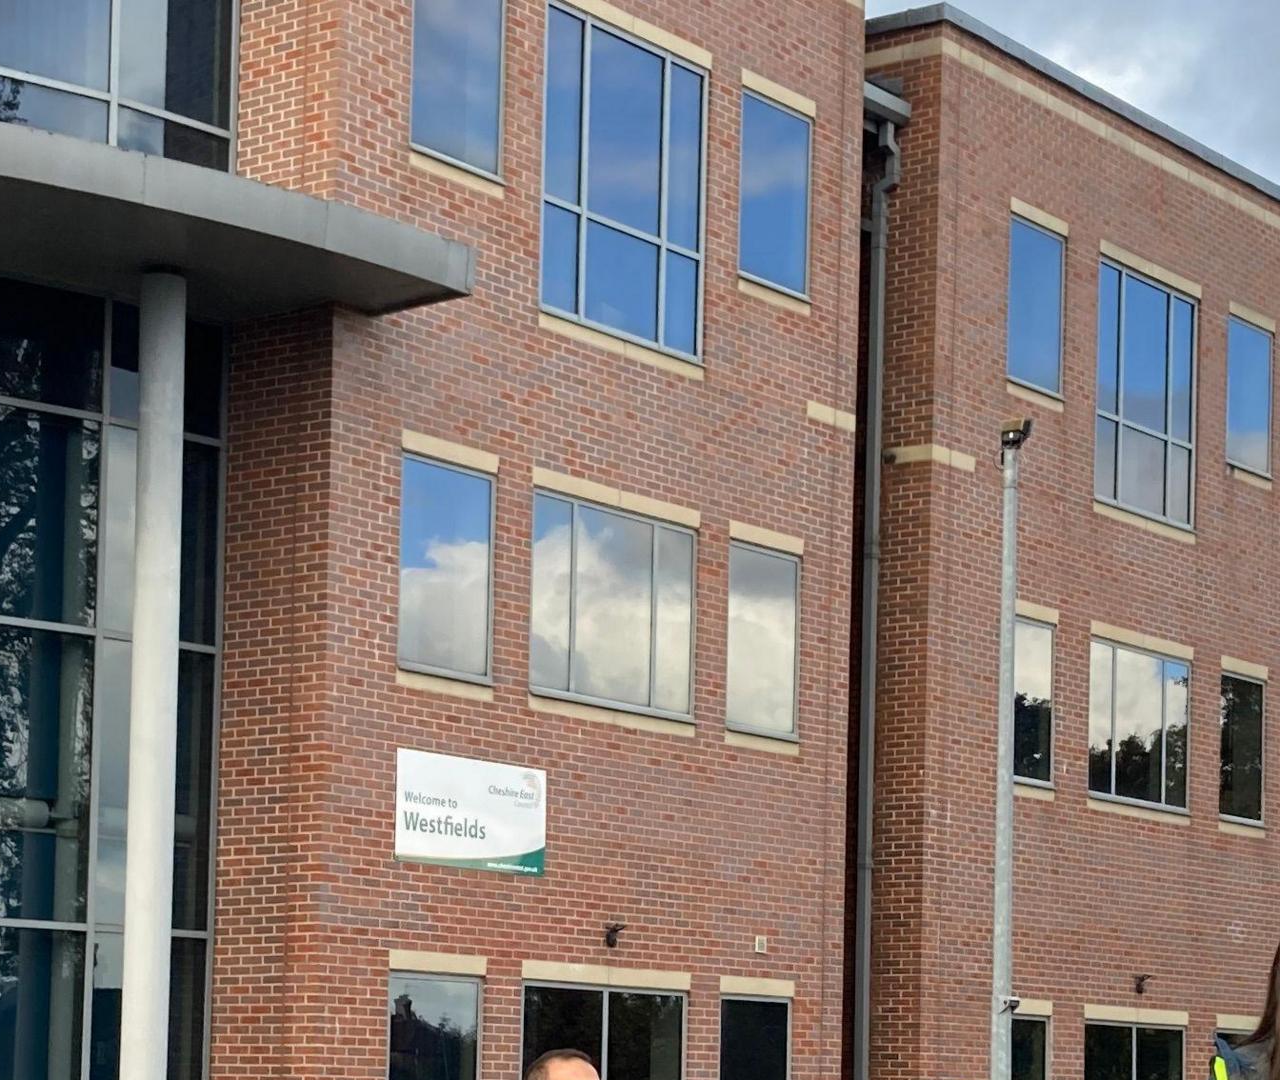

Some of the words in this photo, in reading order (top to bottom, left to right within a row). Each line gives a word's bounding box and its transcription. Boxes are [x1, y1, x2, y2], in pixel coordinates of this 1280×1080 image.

[404, 791, 446, 808] Welcome
[448, 798, 458, 808] to
[488, 785, 518, 798] Cheshire
[403, 811, 486, 839] Westfields
